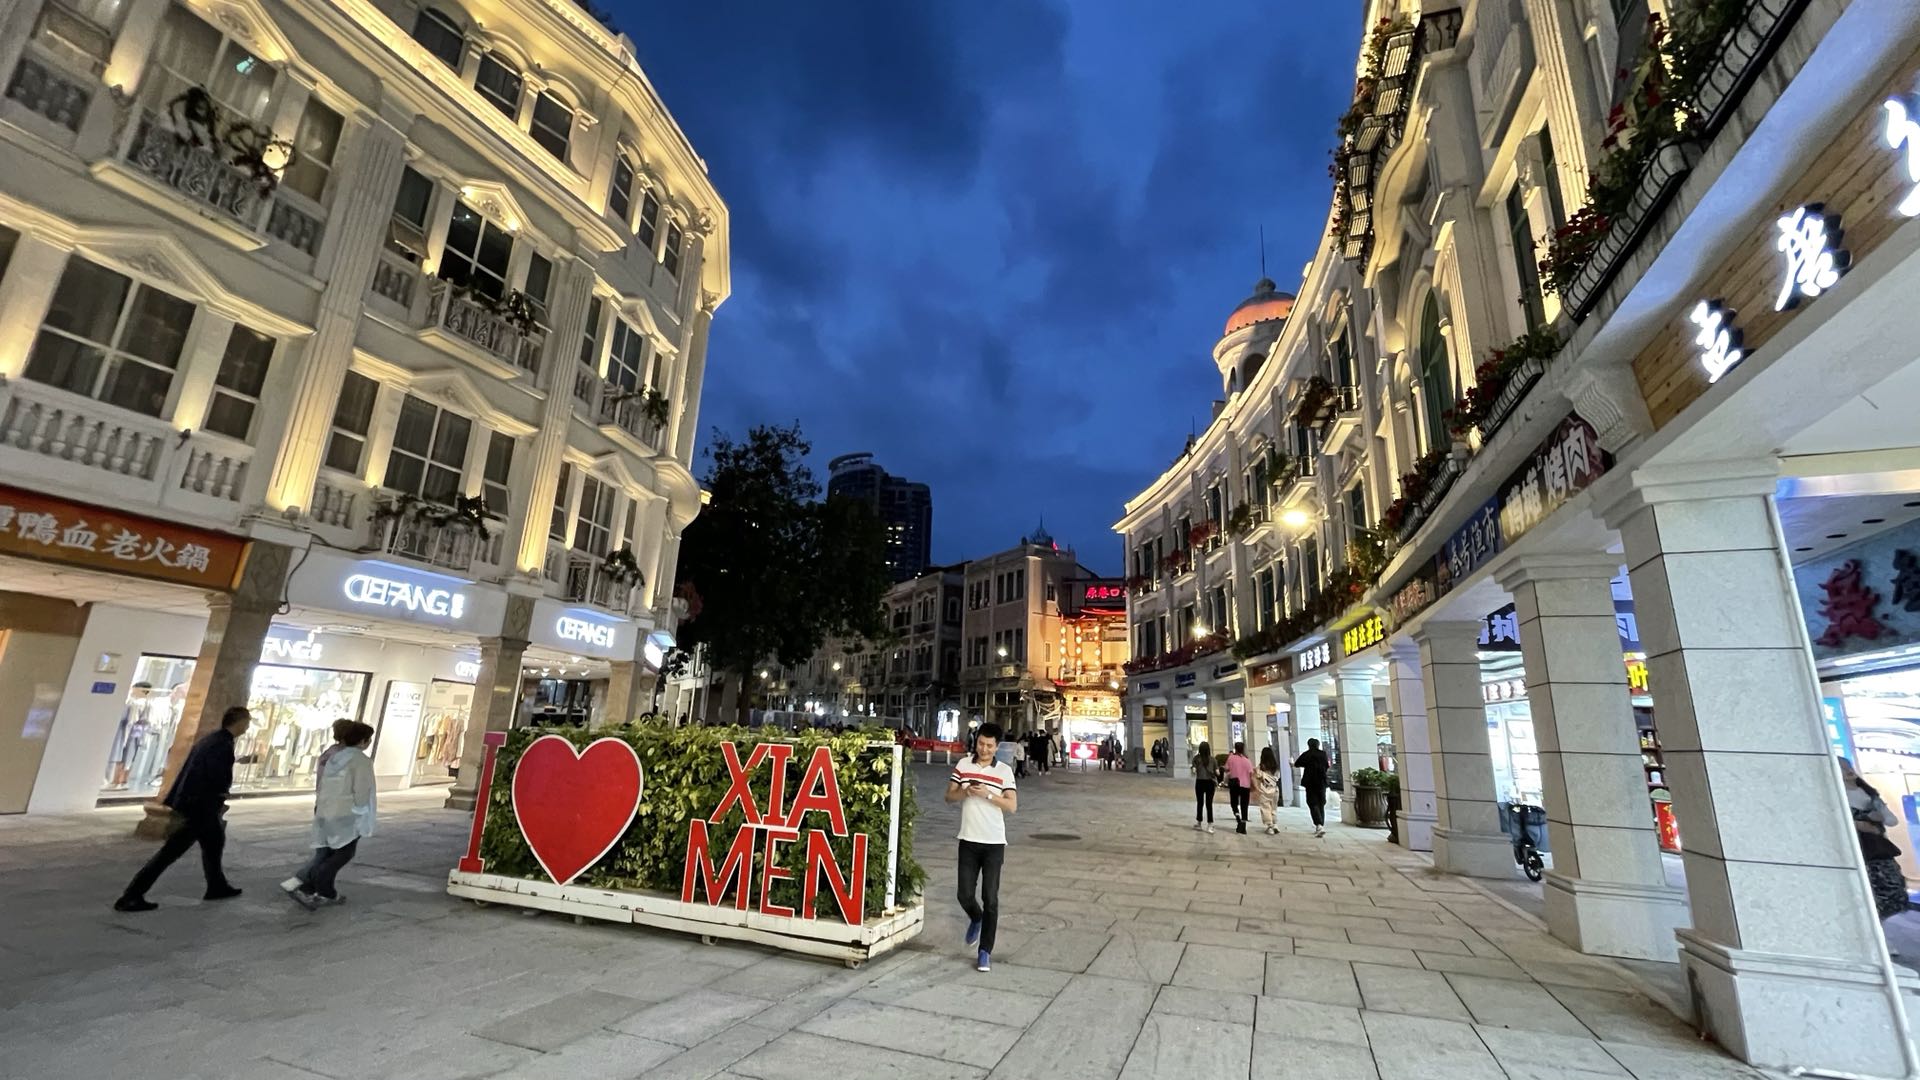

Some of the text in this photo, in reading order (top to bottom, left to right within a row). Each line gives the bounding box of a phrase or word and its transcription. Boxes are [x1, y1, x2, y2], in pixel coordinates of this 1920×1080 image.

[458, 731, 507, 873] I
[709, 741, 848, 836] XIA
[682, 818, 868, 925] MEN
